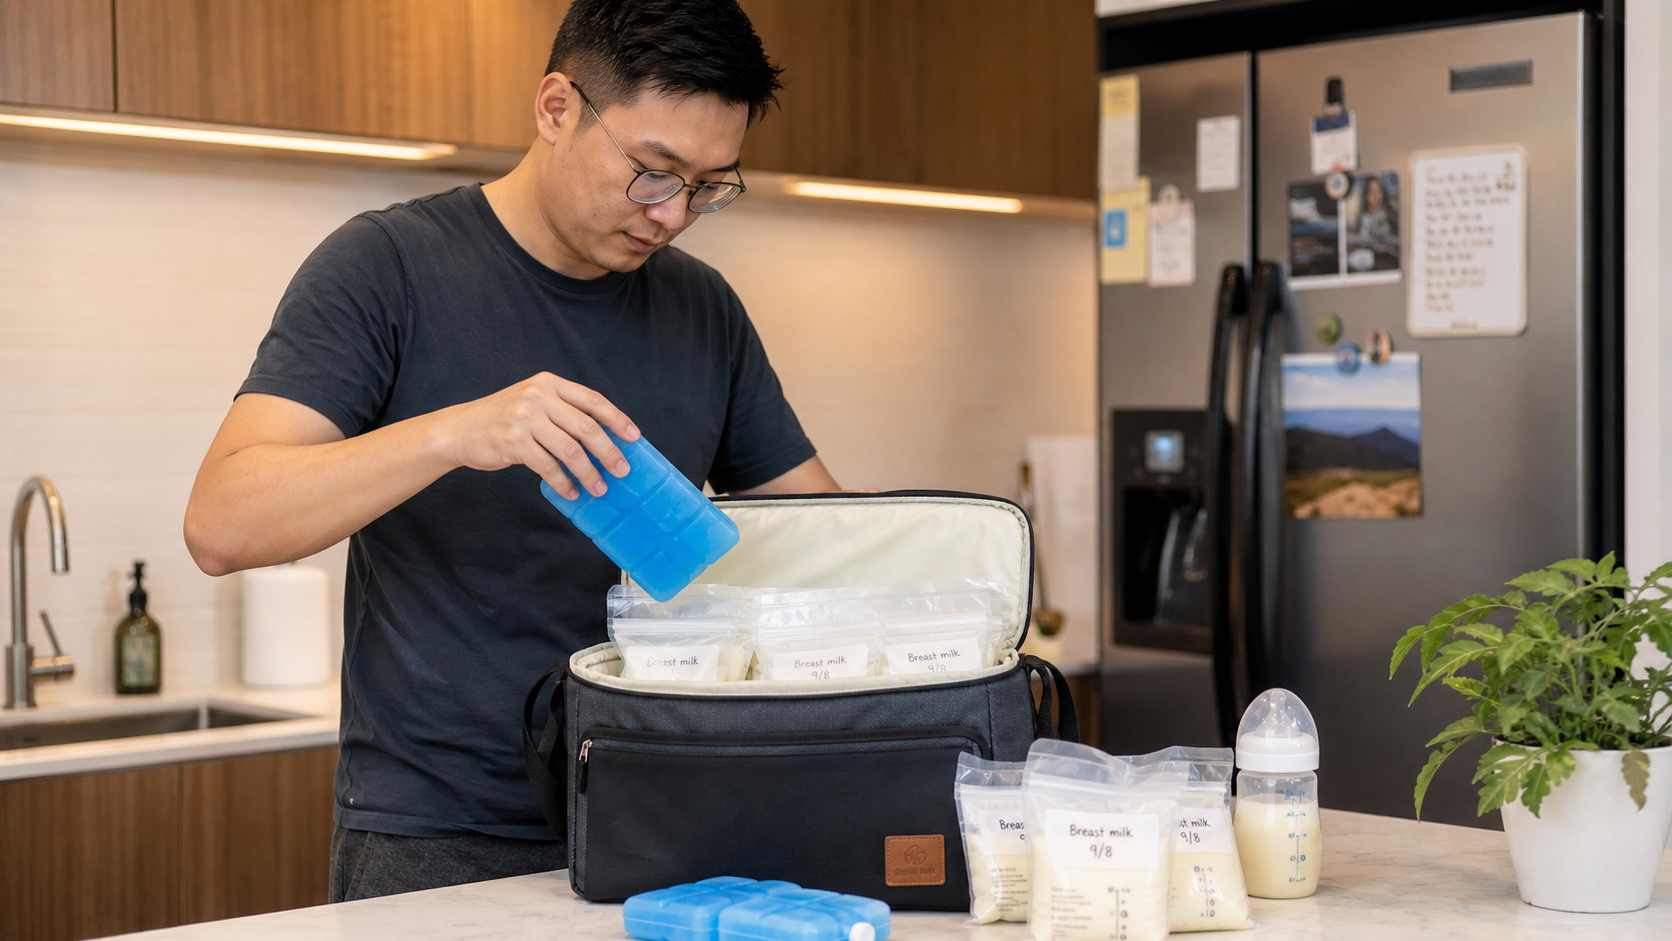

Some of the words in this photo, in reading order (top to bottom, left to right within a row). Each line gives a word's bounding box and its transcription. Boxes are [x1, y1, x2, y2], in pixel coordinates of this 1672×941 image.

[647, 657, 677, 667] Breast
[680, 656, 699, 666] milk
[794, 659, 824, 669] Breast
[827, 655, 847, 665] milk
[907, 652, 937, 662] Breast
[941, 649, 960, 659] milk
[811, 670, 830, 680] 9/8
[999, 819, 1025, 830] Breas
[1190, 817, 1211, 828] milk
[1069, 824, 1105, 838] Breast
[1109, 825, 1134, 838] milk
[1180, 830, 1201, 845] 9/8
[1089, 843, 1113, 859] 9/8
